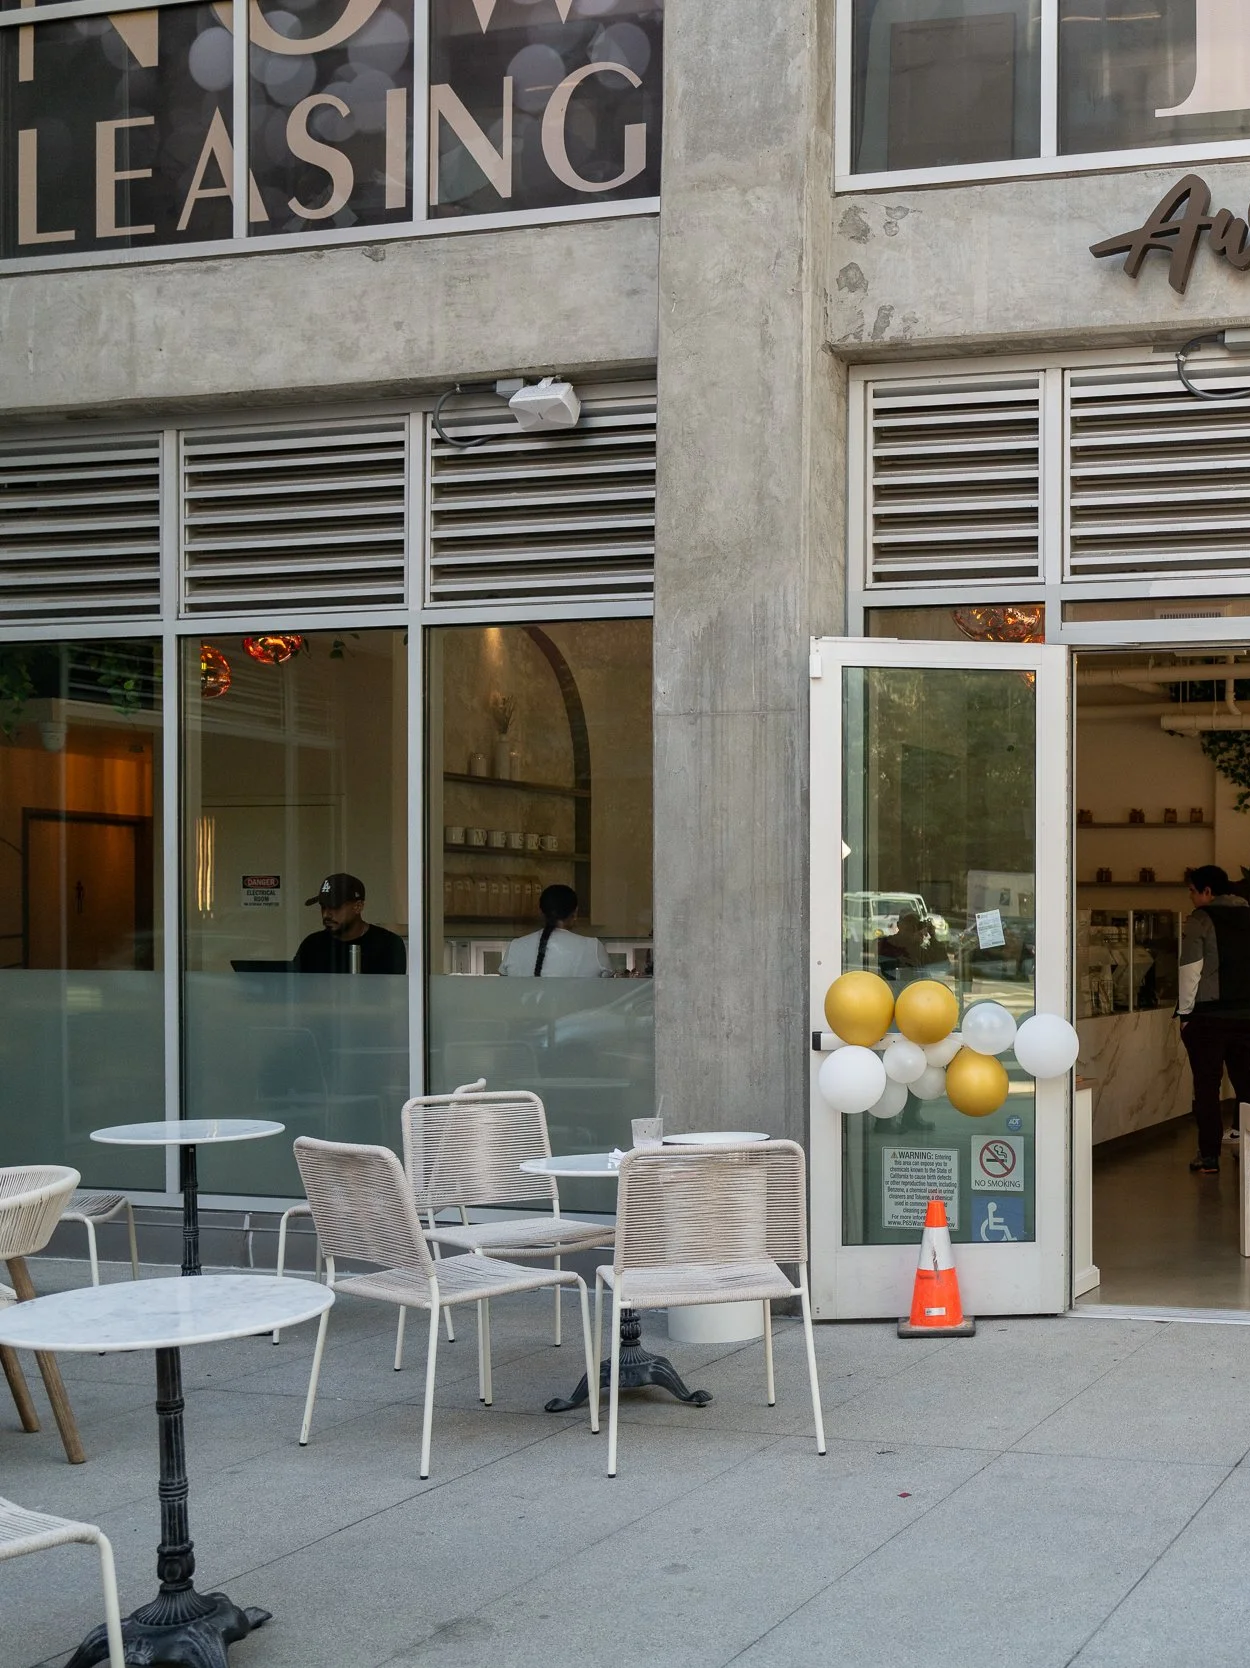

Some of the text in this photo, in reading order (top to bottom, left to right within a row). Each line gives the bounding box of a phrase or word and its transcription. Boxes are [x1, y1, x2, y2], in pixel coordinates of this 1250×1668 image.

[18, 61, 647, 245] LEASING
[247, 878, 275, 886] DANGER
[898, 1151, 934, 1160] WARNING:
[987, 1180, 1021, 1188] SMOKING
